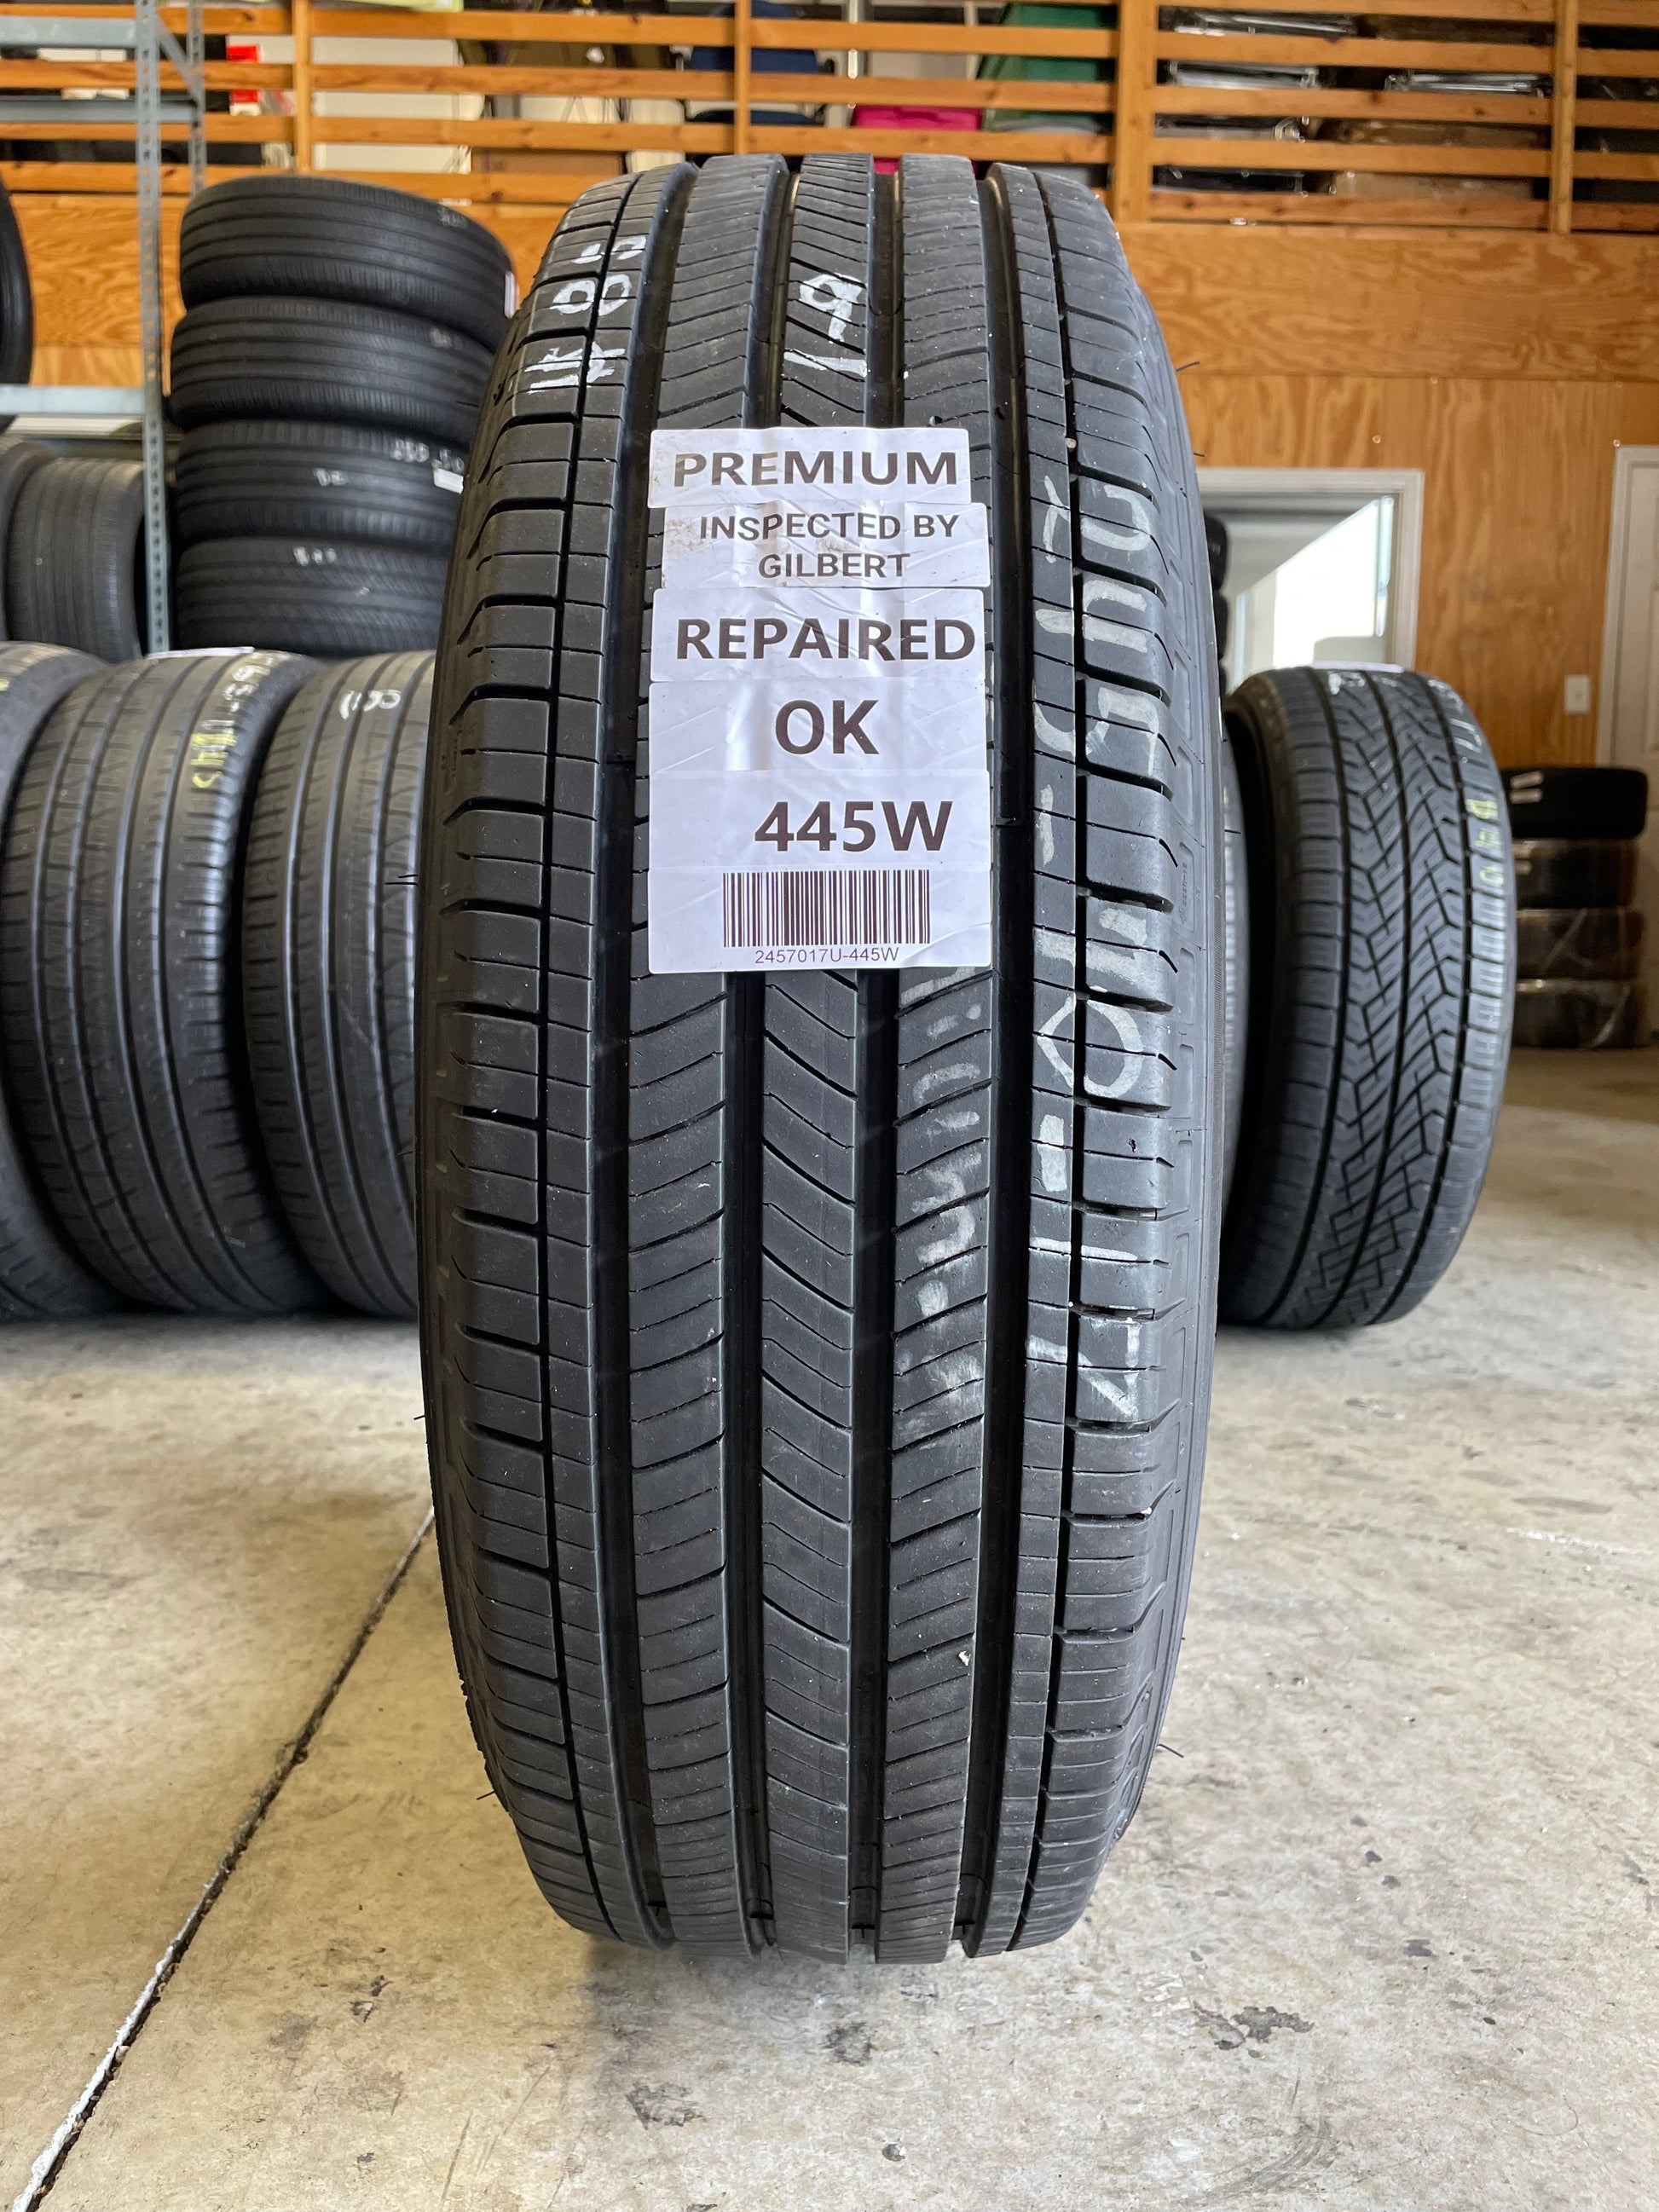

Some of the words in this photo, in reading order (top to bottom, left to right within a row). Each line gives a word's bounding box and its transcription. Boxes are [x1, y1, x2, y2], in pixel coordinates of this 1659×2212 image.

[673, 450, 957, 485] PREMIUM
[700, 512, 901, 541] INSPECTED
[913, 514, 959, 539] BY
[758, 552, 910, 579] GILBERT
[677, 617, 977, 661] REPAIRED
[774, 699, 880, 755] OK
[754, 800, 953, 852] 445W
[754, 945, 900, 966] 2457017U-445W
